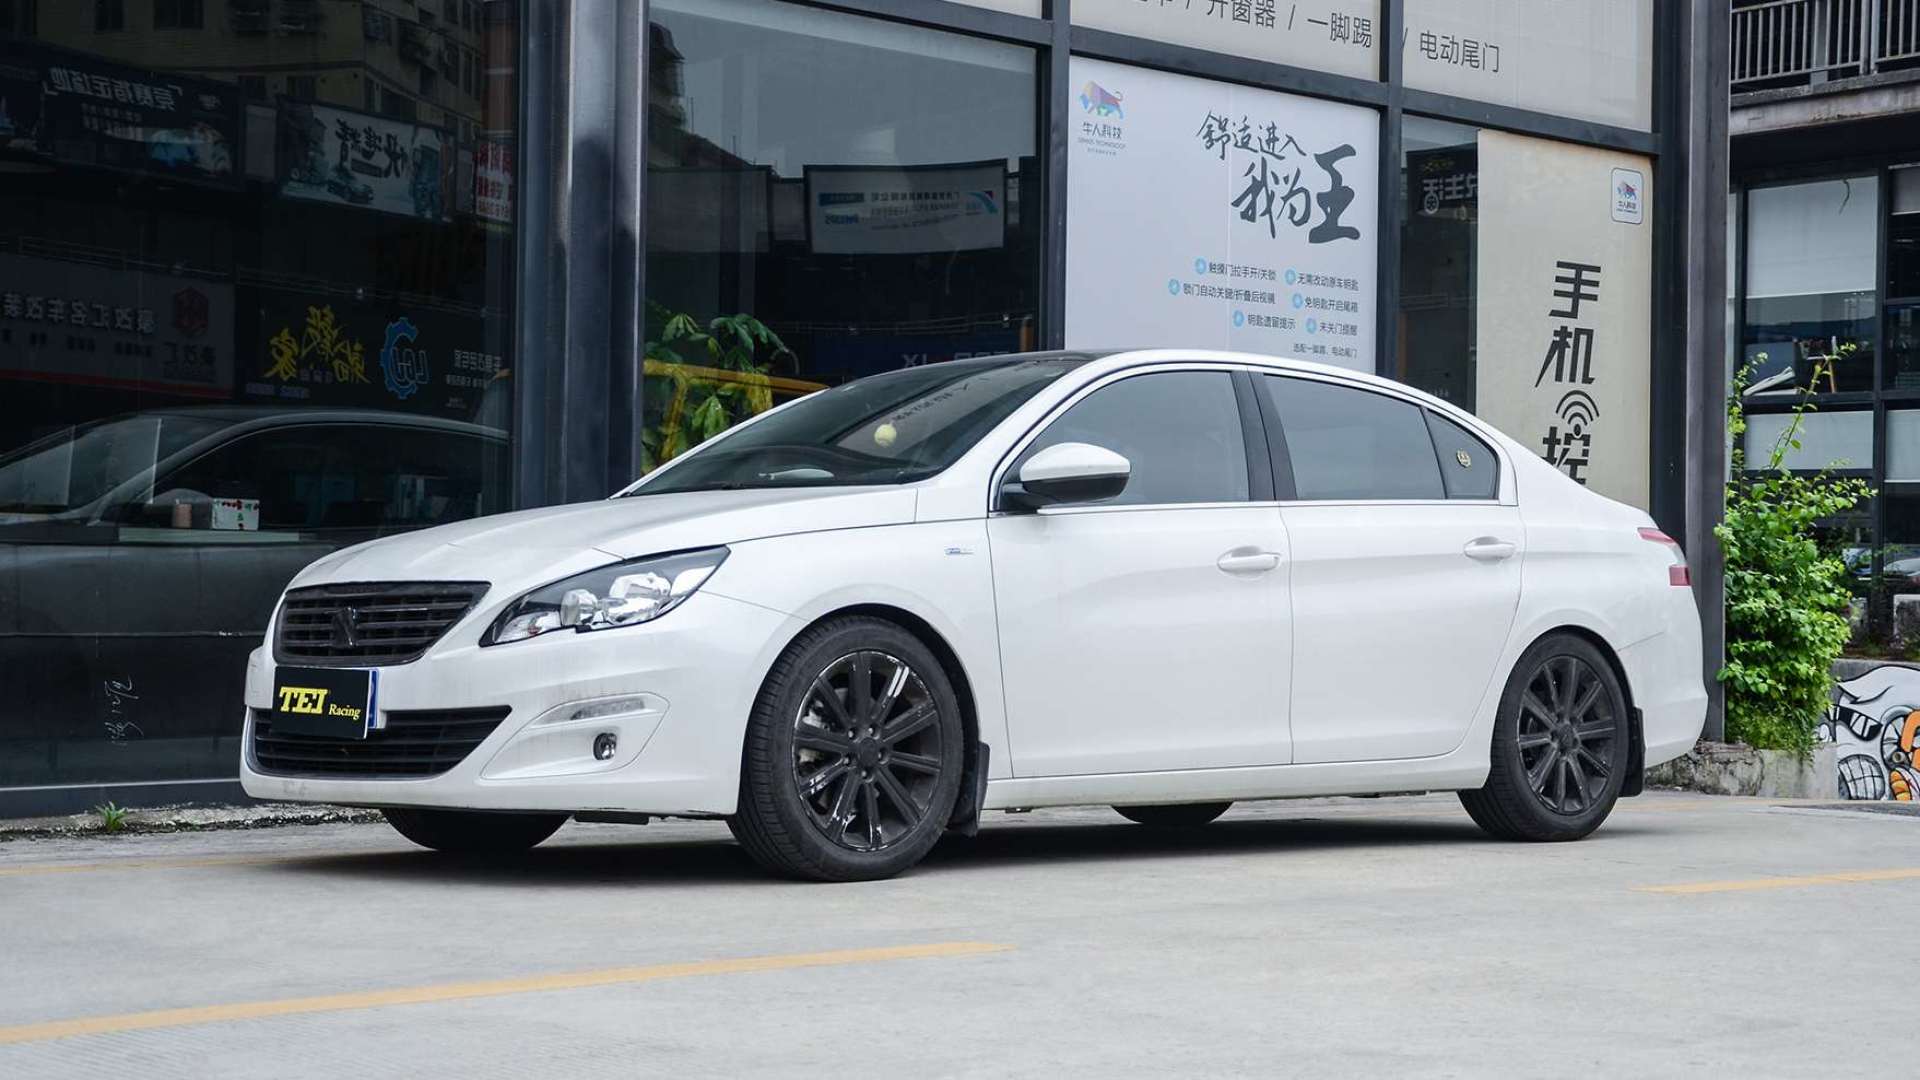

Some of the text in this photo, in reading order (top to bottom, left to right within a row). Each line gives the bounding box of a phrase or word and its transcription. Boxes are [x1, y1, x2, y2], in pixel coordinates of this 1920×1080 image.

[1307, 12, 1372, 48] 一脚踢
[1419, 30, 1500, 73] 电动尾门
[1082, 121, 1122, 139] 牛人科技
[1196, 110, 1307, 160] 舒适进入
[1230, 143, 1361, 244] 我为王
[1247, 313, 1296, 329] 钥匙遗留提示
[1304, 296, 1359, 313] 免钥匙开启尾箱
[1319, 322, 1358, 336] 未关门提醒
[279, 686, 361, 721] TEI Racing
